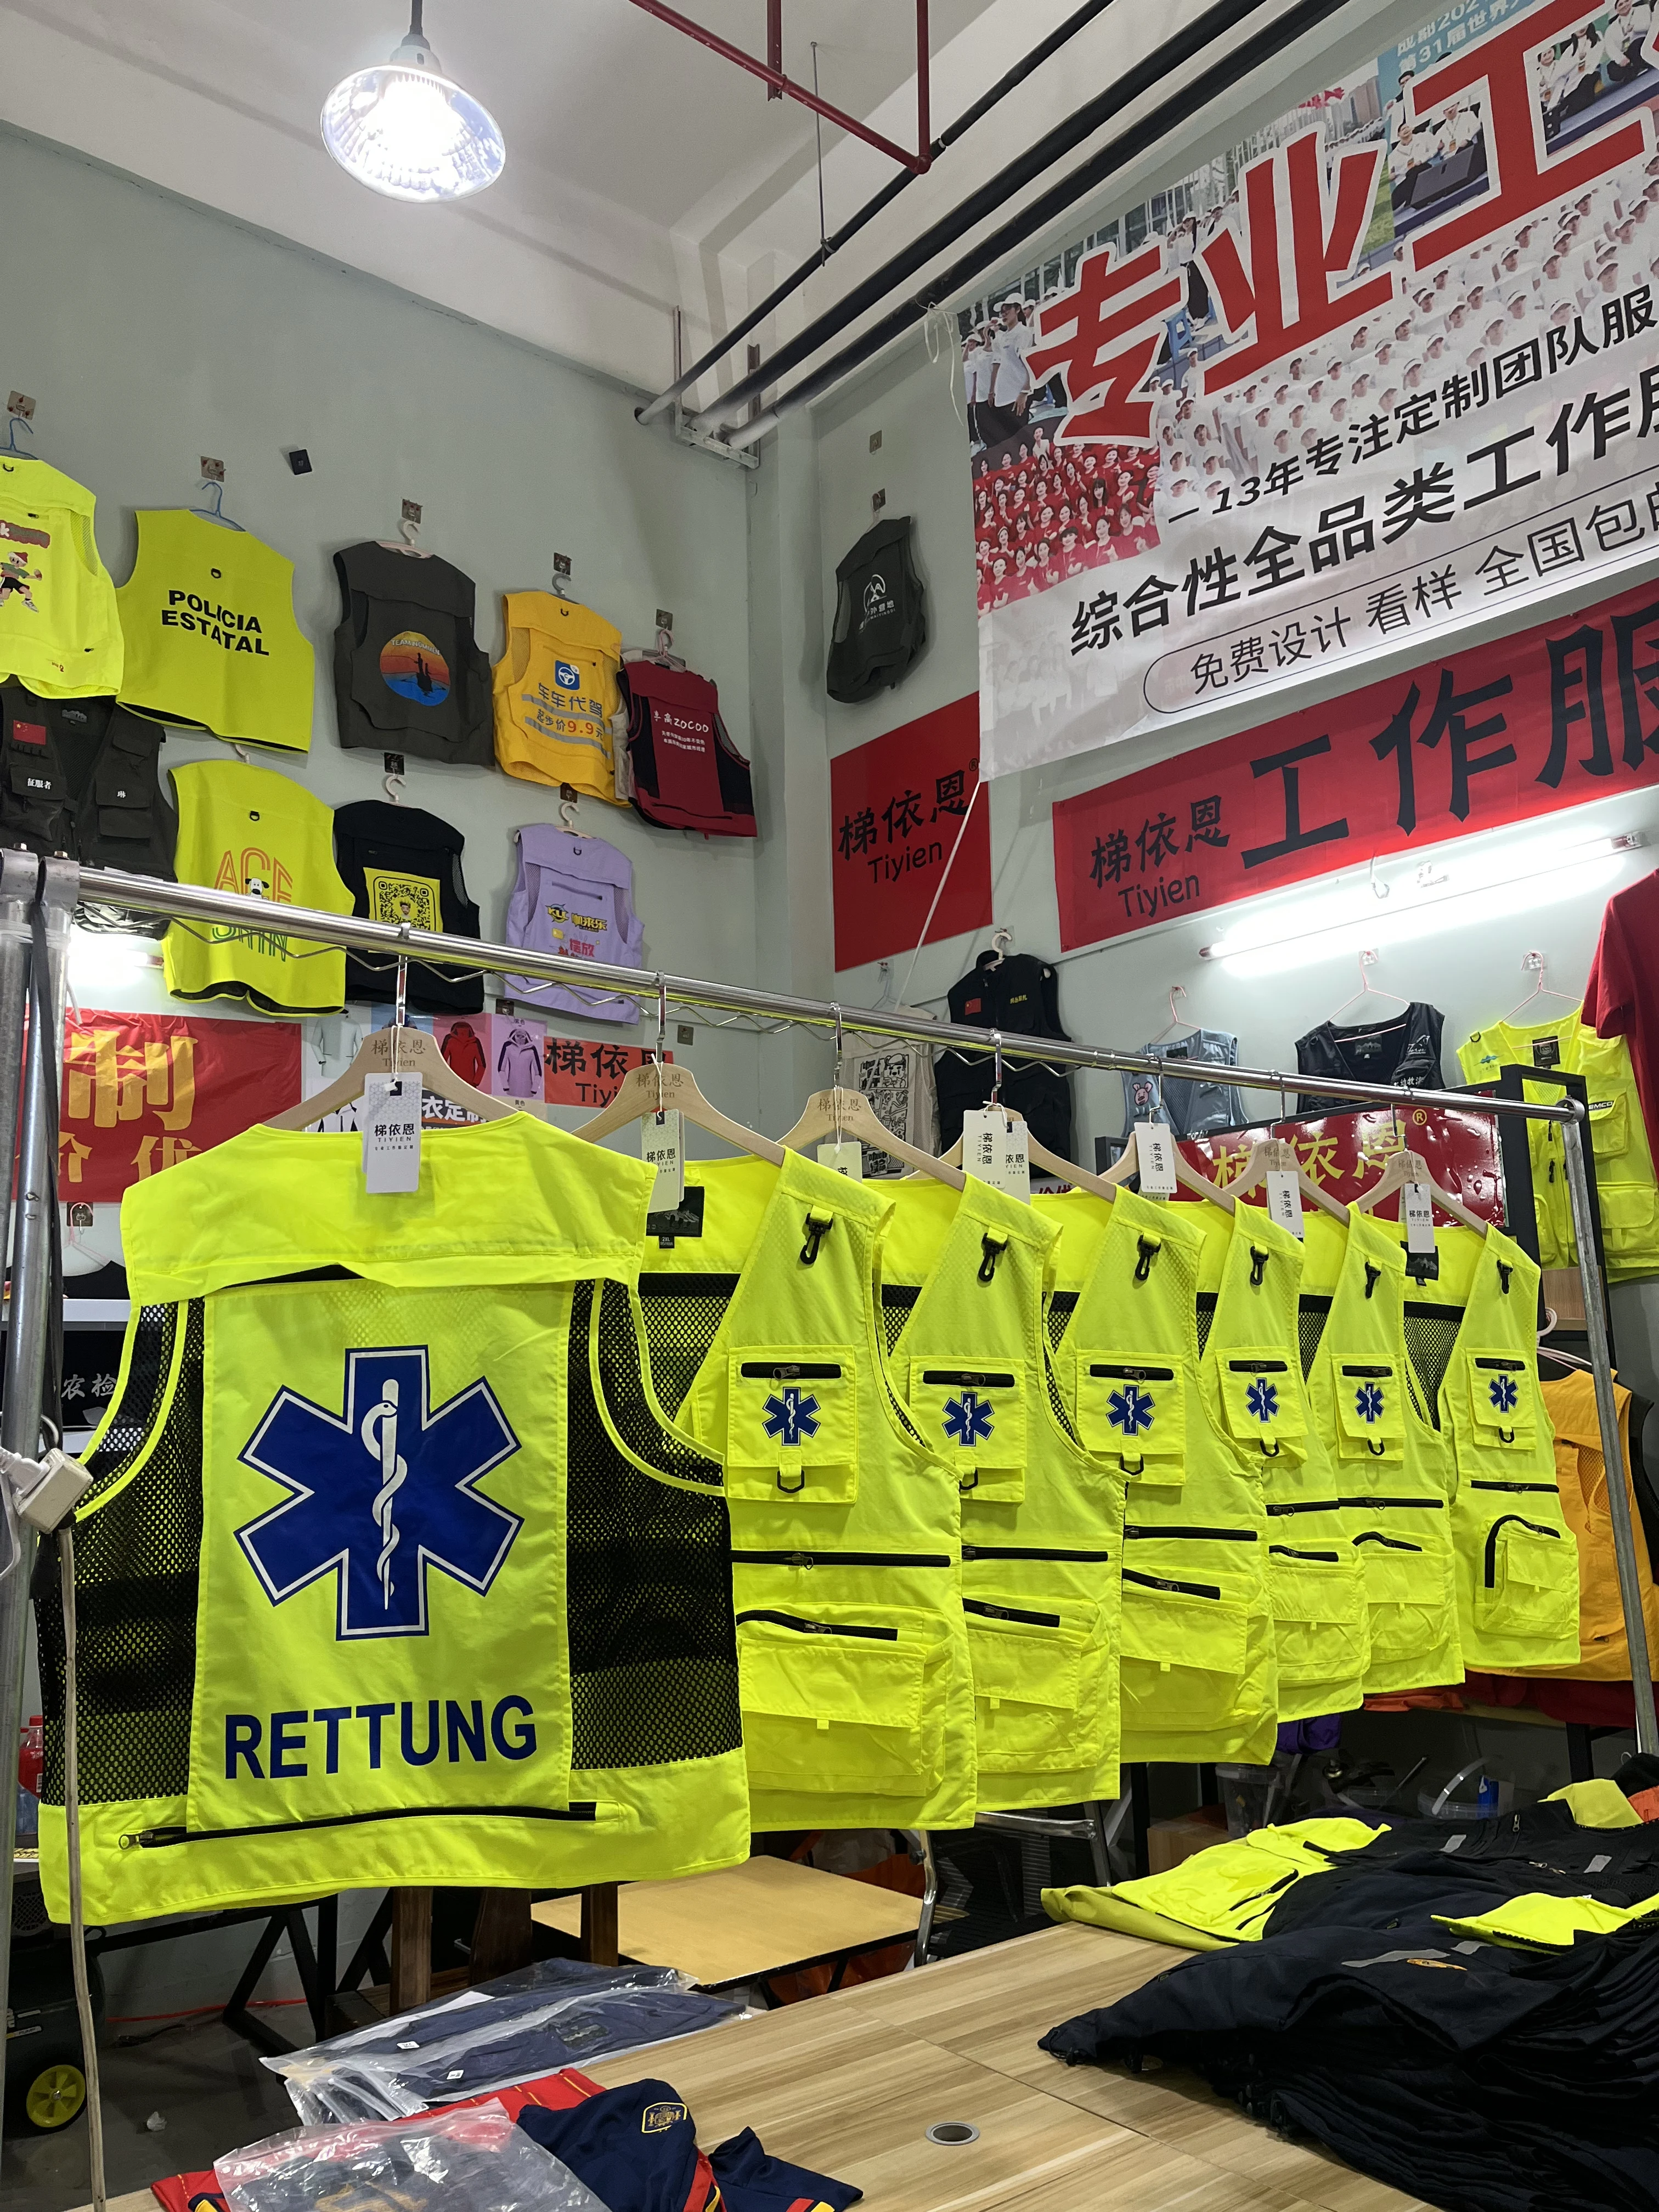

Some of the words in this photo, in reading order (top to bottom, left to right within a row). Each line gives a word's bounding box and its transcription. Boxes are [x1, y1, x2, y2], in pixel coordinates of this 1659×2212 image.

[1397, 0, 1488, 57] 成都202
[1399, 0, 1519, 72] 第31届世界
[1026, 0, 1659, 439] 专业工
[162, 610, 269, 656] ESTATAL
[168, 589, 262, 633] POLICIA
[1190, 607, 1353, 695] 免费设计
[1365, 565, 1463, 636] 看样
[837, 769, 970, 861] 梯依恩
[867, 841, 943, 884] Tiyien
[1089, 794, 1231, 890] 梯依恩
[1118, 874, 1200, 918] Tiyien
[65, 1029, 199, 1131] 制
[374, 1124, 415, 1136] 梯依恩
[982, 1132, 993, 1164] 梯依恩
[646, 1148, 676, 1163] 梯依恩
[1006, 1154, 1025, 1163] 依恩
[1153, 1143, 1164, 1171] 梯依恩
[1409, 1210, 1430, 1218] 梯依恩
[224, 1694, 538, 1780] RETTUNG
